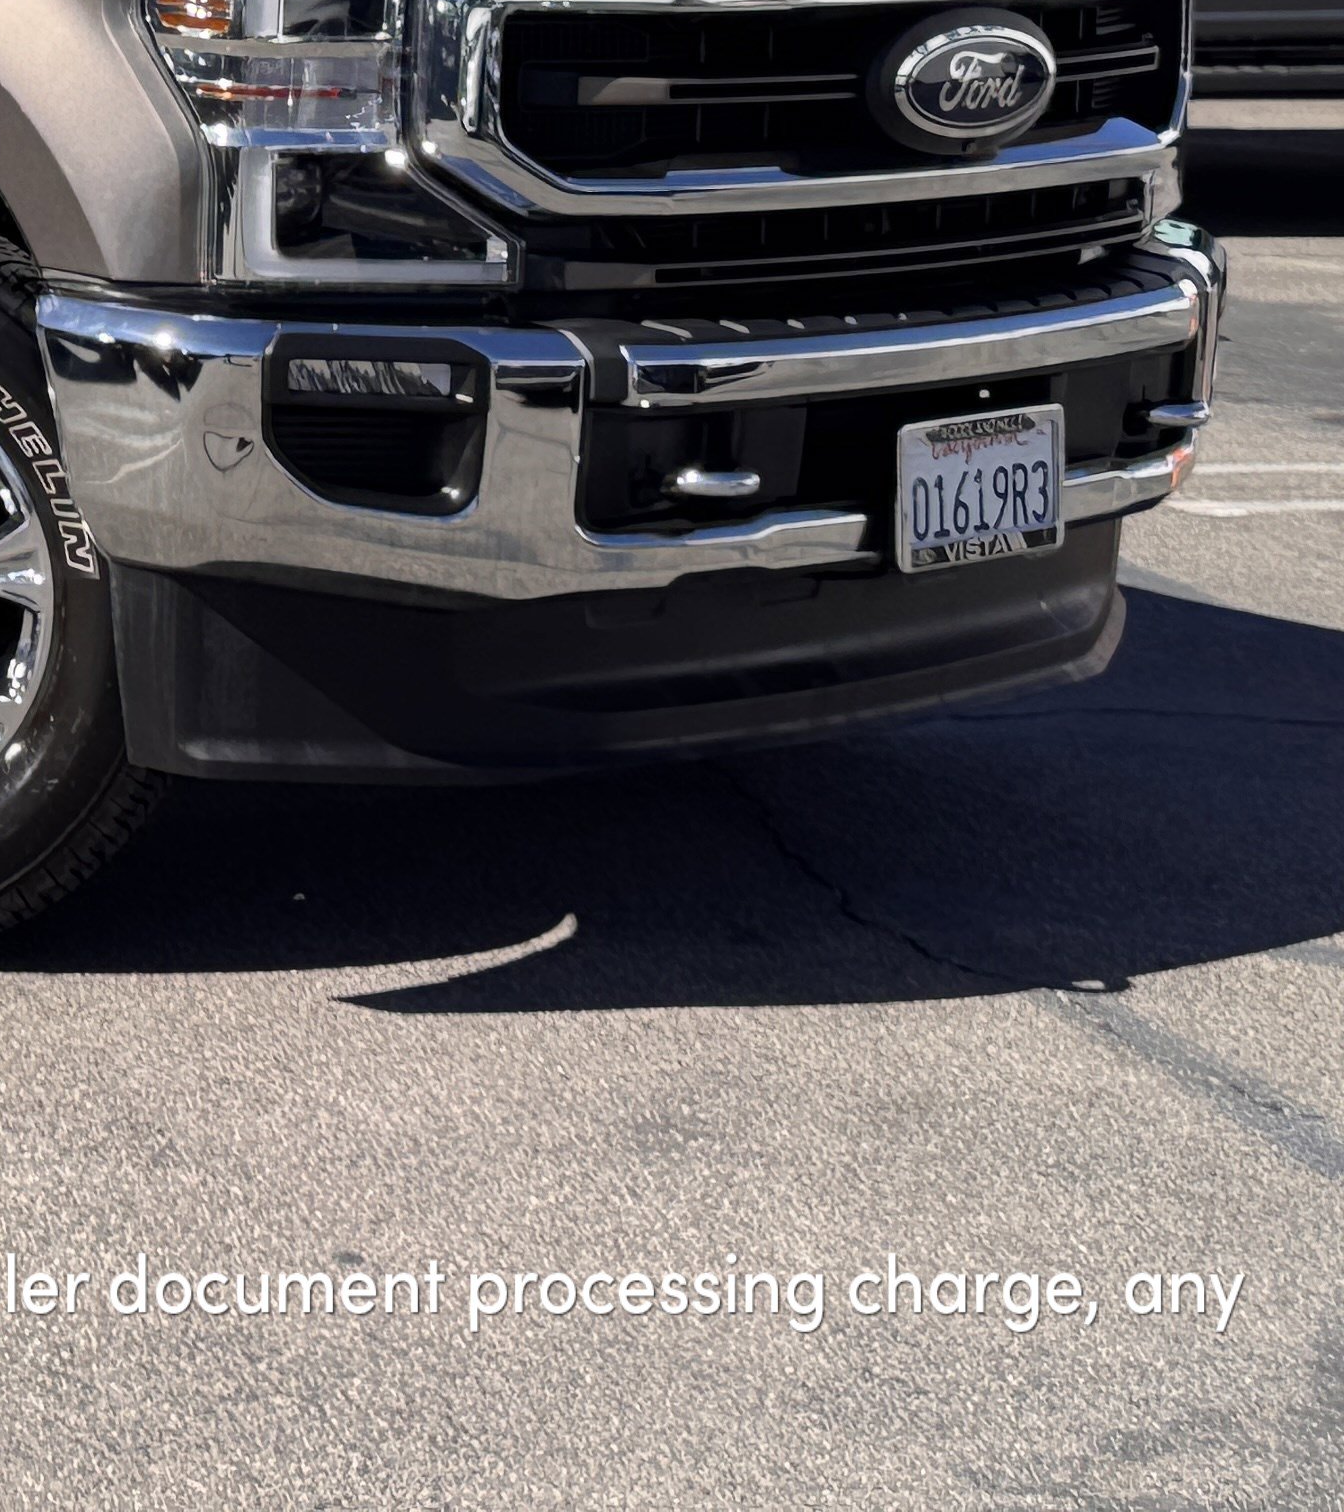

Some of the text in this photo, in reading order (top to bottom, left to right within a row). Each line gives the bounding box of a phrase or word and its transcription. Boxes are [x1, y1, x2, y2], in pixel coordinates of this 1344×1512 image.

[938, 50, 1025, 112] Ford
[912, 459, 1050, 542] 01619R3
[944, 533, 1014, 562] VISTA
